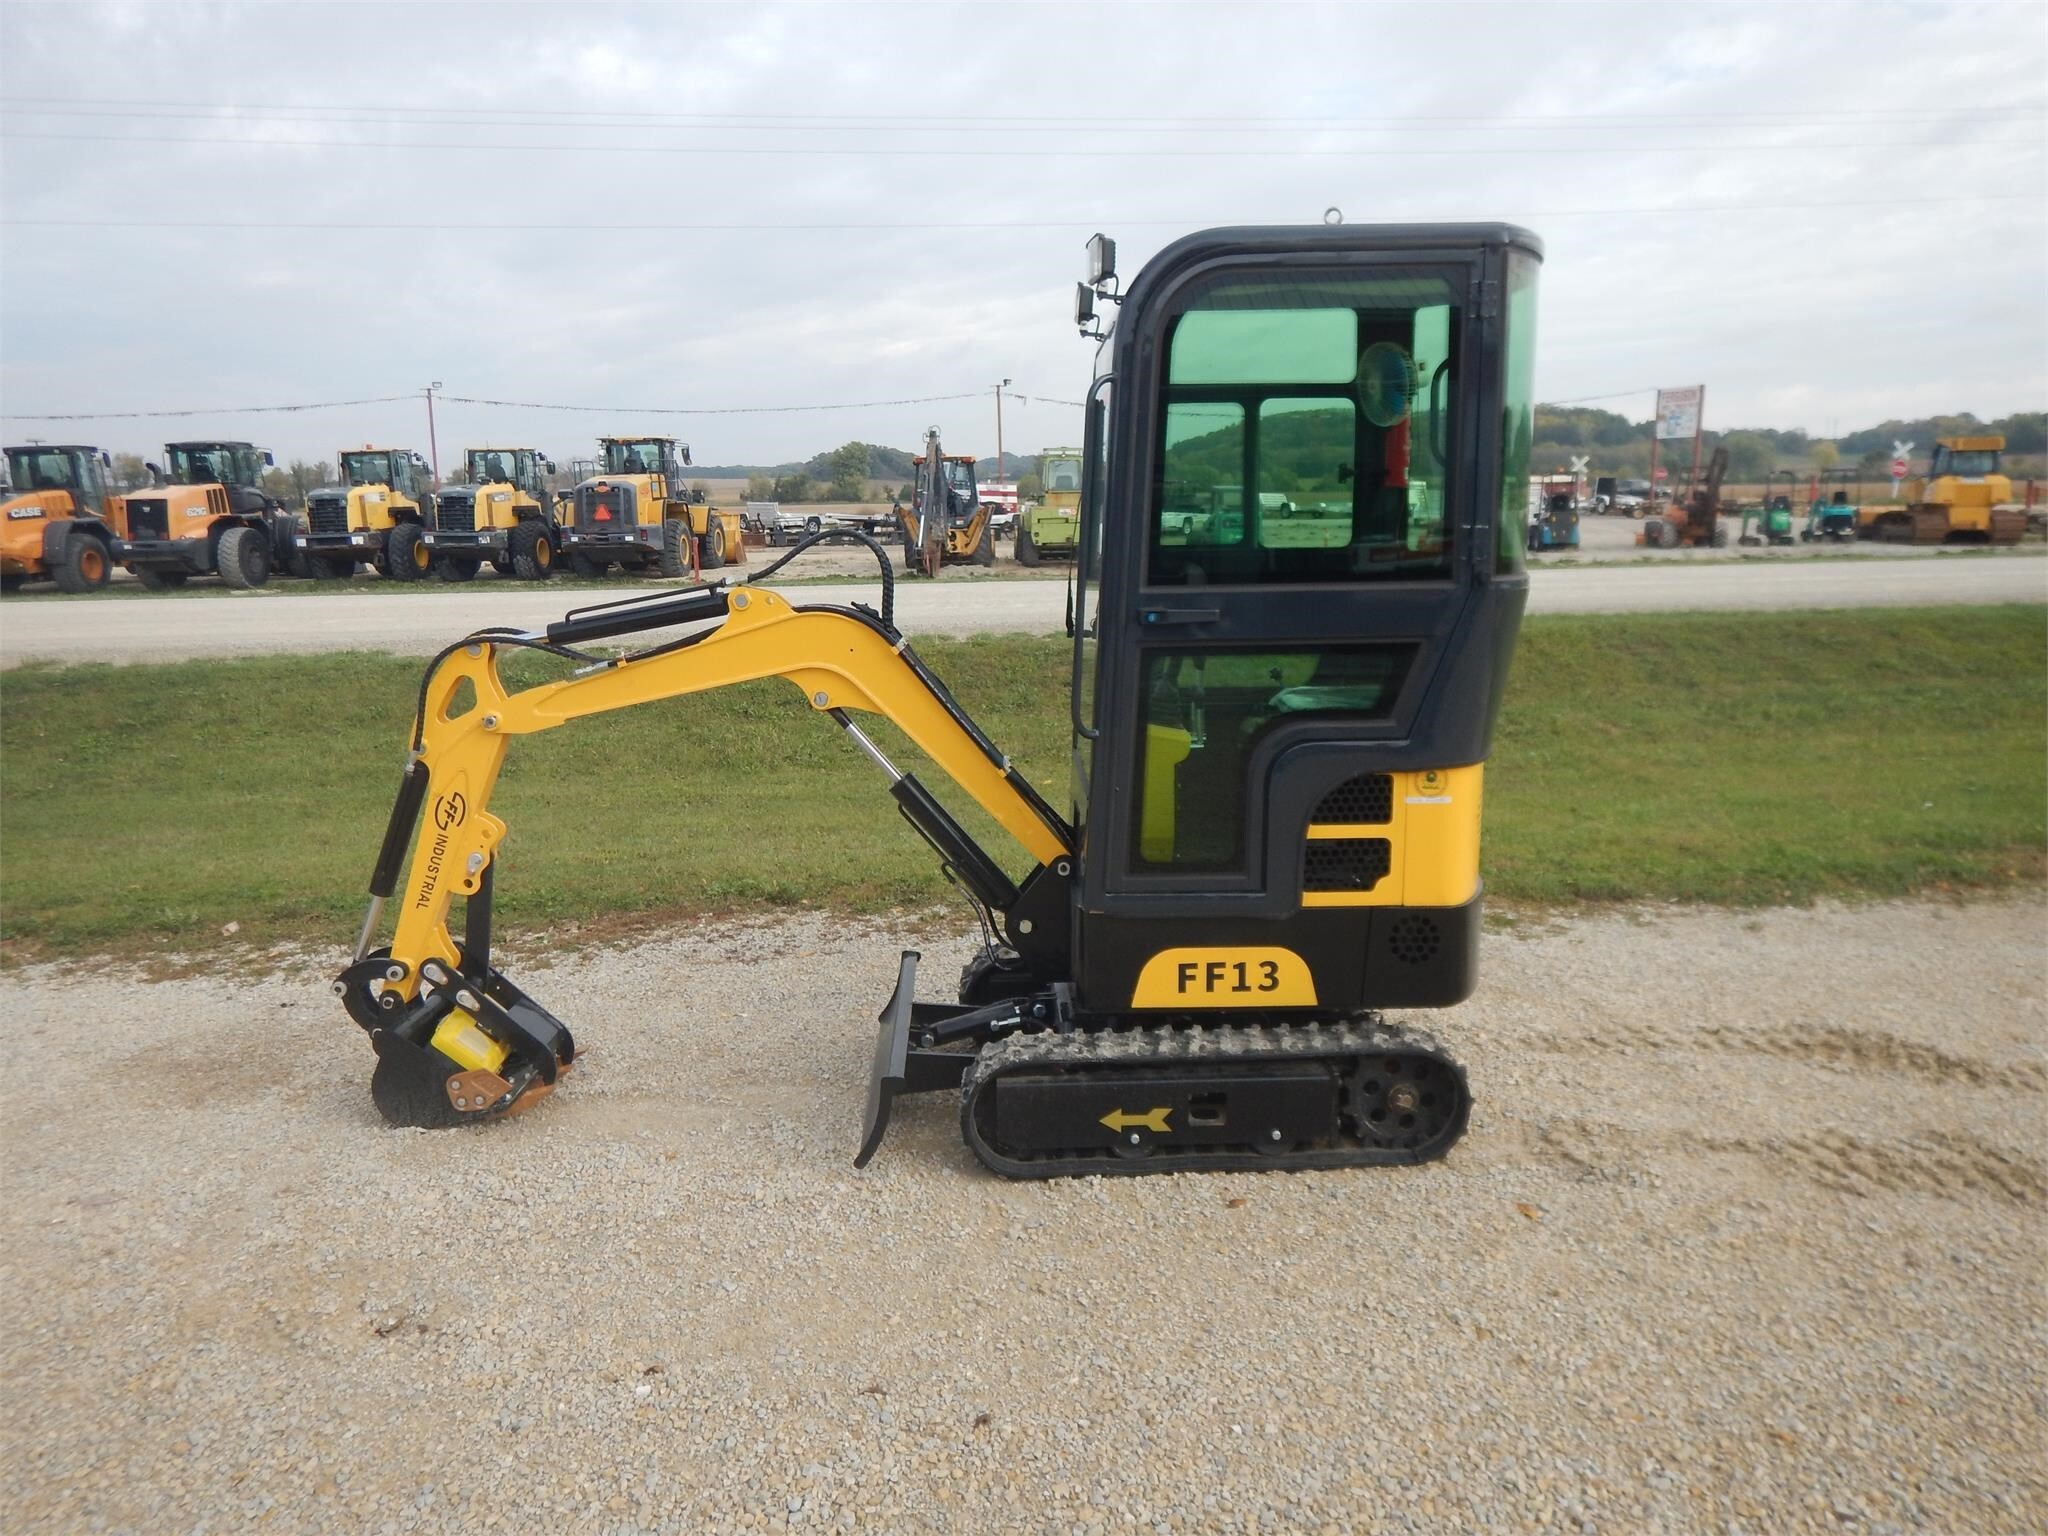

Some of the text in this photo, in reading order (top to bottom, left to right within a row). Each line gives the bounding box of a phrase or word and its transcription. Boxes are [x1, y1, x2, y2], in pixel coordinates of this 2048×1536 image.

[11, 506, 41, 518] CASE
[416, 833, 449, 909] INDUSTRIAL
[1178, 960, 1280, 993] FF13
